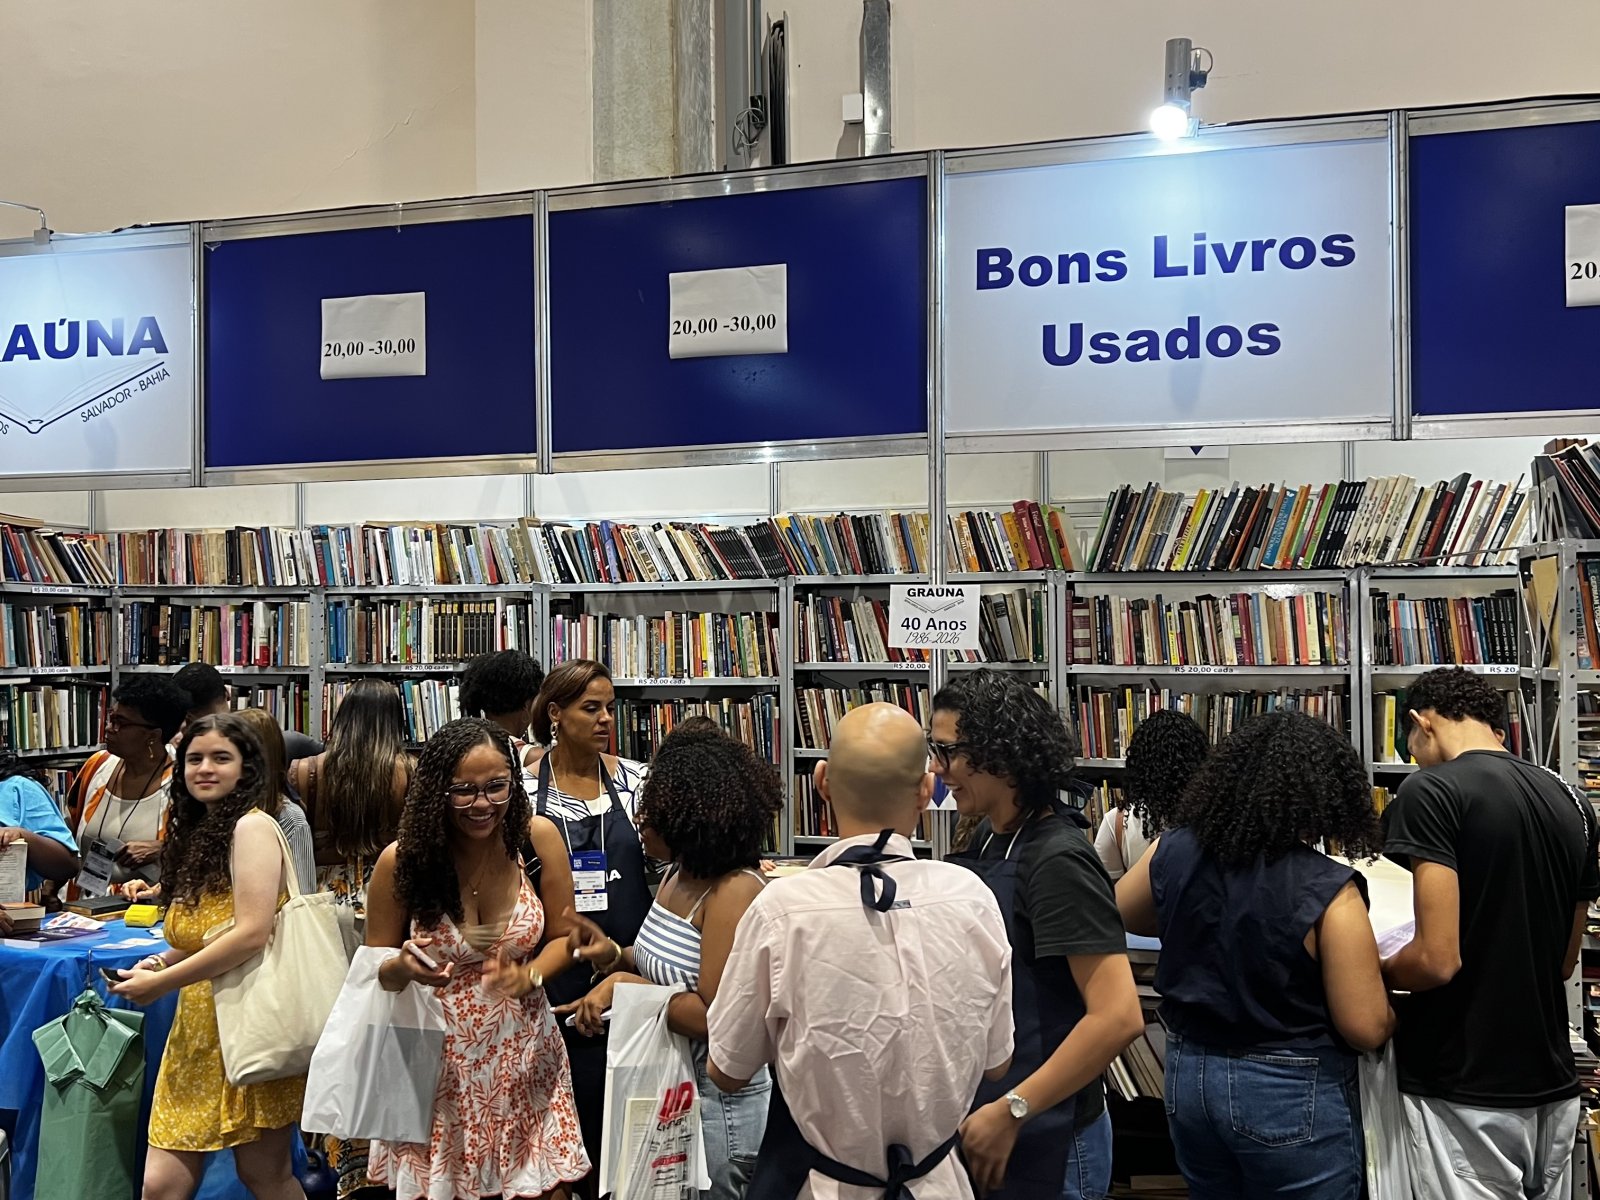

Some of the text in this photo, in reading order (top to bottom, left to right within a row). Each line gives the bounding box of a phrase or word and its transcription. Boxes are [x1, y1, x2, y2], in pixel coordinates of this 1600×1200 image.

[976, 232, 1356, 290] Bons Livros
[672, 314, 776, 337] 20,00 -30,00
[324, 338, 416, 359] 20,00 -30,00
[1042, 314, 1282, 366] Usados
[80, 388, 132, 423] SALVADOR
[139, 368, 170, 392] BAHIA
[901, 617, 966, 630] 40 Anos
[905, 631, 961, 644] 1986-2026
